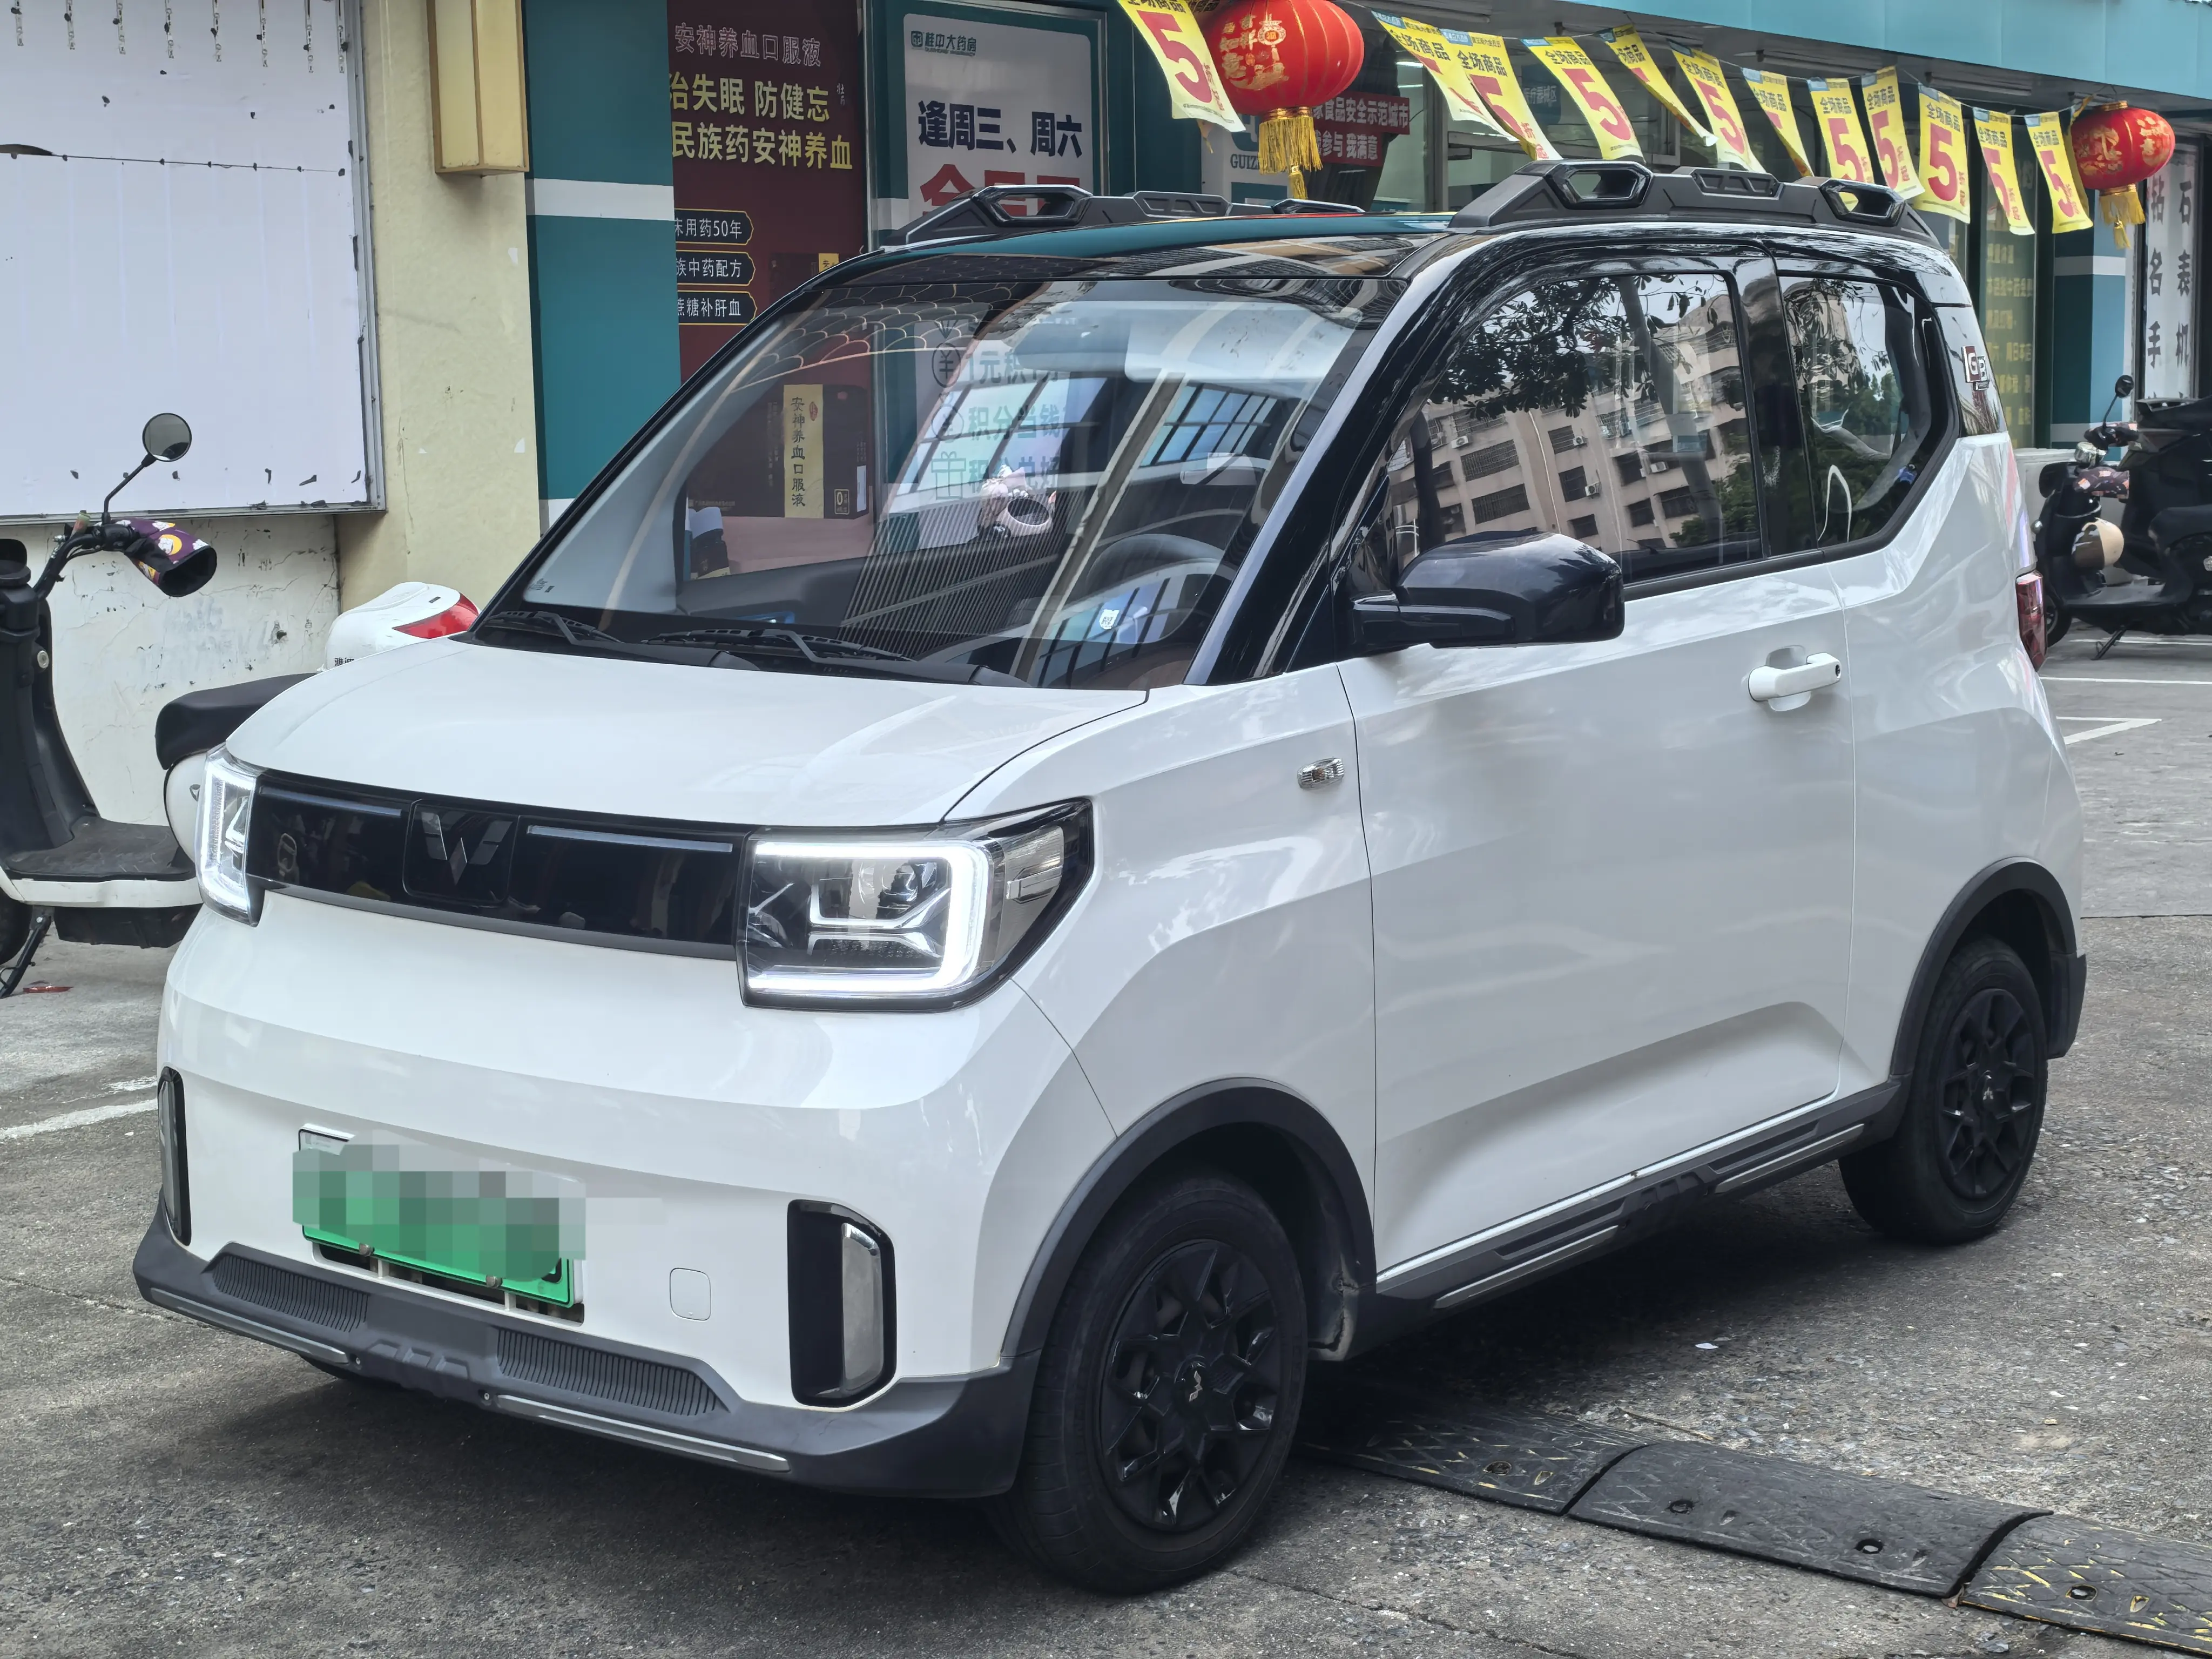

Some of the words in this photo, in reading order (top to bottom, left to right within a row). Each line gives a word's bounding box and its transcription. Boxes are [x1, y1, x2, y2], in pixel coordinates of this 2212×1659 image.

[675, 22, 821, 67] 安神养血口服液
[1136, 10, 1213, 103] 5
[1457, 50, 1508, 77] 全场商品
[1545, 50, 1592, 66] 全场商品
[669, 71, 745, 115] 治失眠
[754, 80, 831, 122] 防健忘
[1561, 68, 1631, 140] 5
[1693, 77, 1745, 154] 5
[1820, 97, 1852, 114] 全场商品
[1867, 85, 1896, 111] 全场商品
[1926, 102, 1961, 133] 全场商品
[672, 122, 853, 170] 民族药安神养血
[918, 100, 1083, 158] 逢周三、周六
[1827, 118, 1865, 182] 5
[1871, 110, 1899, 190] 5
[1978, 126, 2008, 149] 全场商品
[1230, 153, 1260, 171] GUIZ
[1927, 122, 1959, 201] 5
[791, 396, 806, 507] 安神养血口服液
